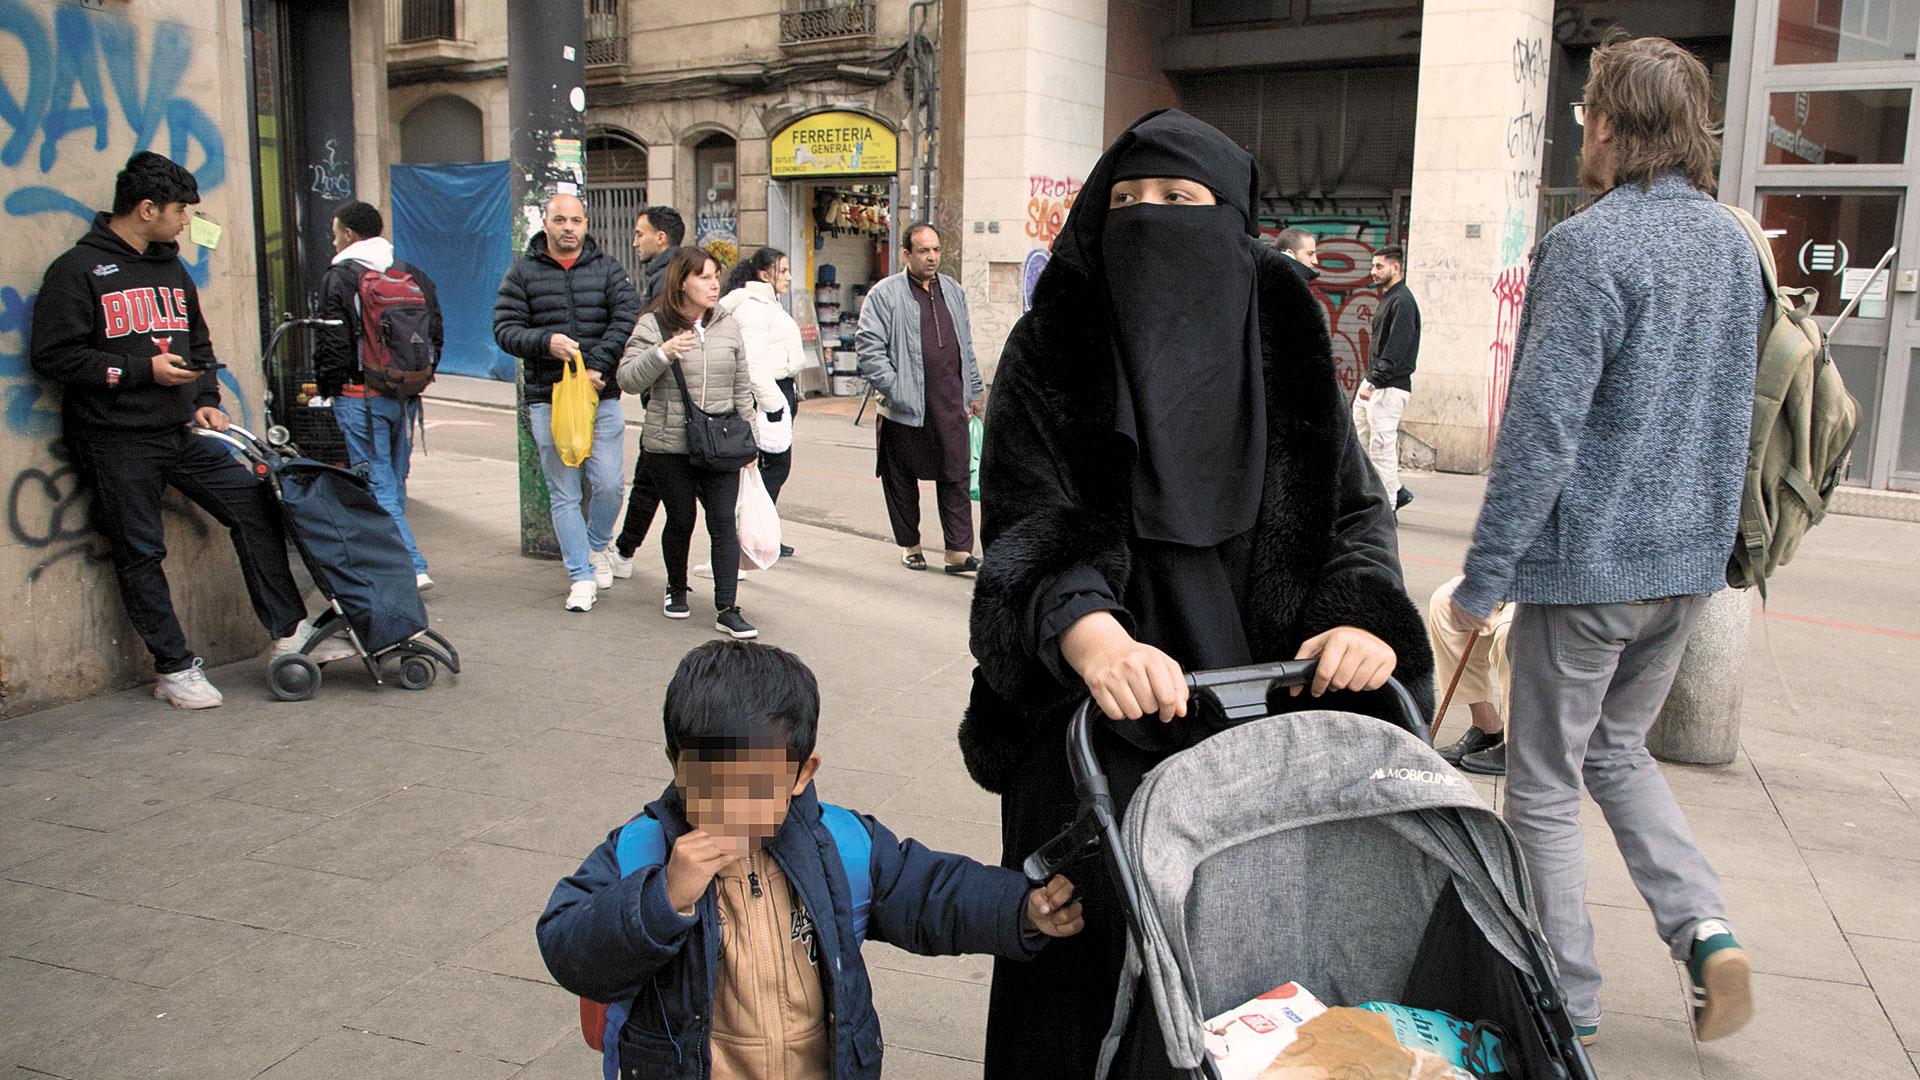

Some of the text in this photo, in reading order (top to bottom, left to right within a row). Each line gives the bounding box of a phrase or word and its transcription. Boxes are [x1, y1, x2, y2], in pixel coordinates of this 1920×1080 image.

[792, 127, 873, 144] FERRETERIA
[811, 143, 854, 155] GENERAL
[1386, 767, 1462, 786] MOBICLINIC
